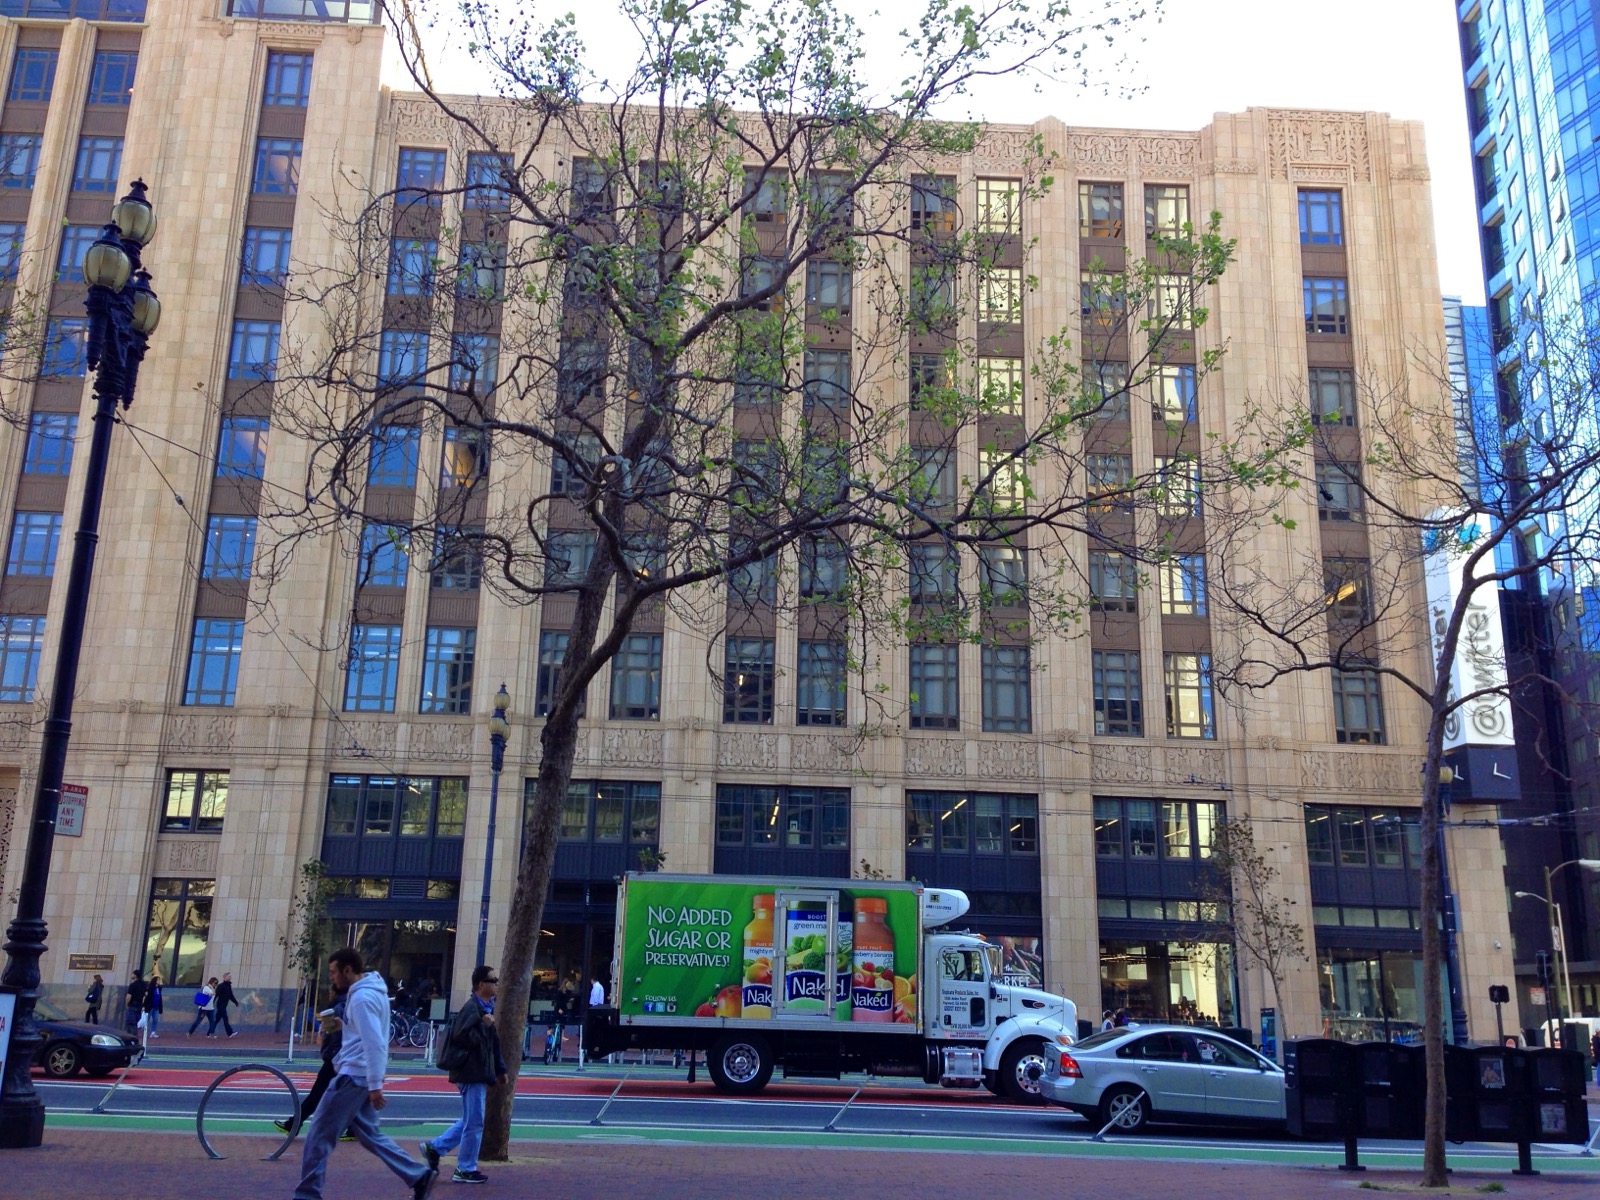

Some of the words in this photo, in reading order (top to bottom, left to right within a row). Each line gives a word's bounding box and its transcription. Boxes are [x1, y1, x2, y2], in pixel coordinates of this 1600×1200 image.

[61, 807, 76, 817] ANY
[59, 817, 75, 827] TIME
[648, 905, 676, 926] NO
[677, 906, 732, 926] ADDED
[793, 922, 815, 930] green
[645, 929, 702, 950] SUGAR
[705, 931, 731, 950] OR
[645, 951, 730, 968] PRESERVATIVES!
[1004, 976, 1030, 987] RKET
